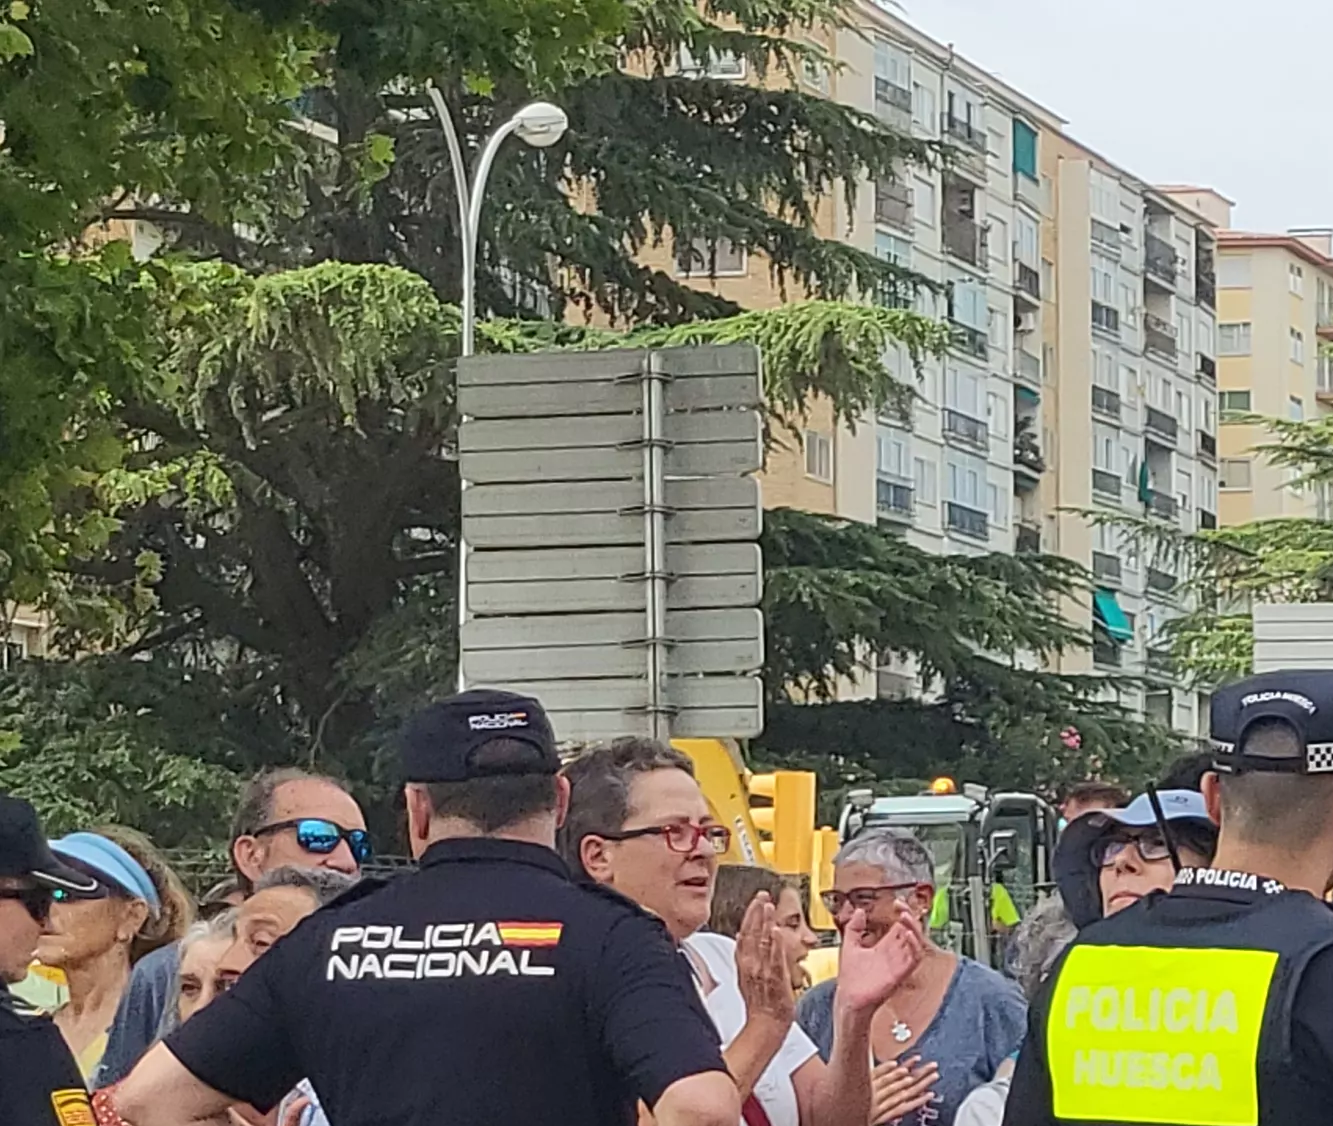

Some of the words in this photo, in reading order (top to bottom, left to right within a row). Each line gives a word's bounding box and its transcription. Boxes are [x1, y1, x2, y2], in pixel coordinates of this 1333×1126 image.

[1196, 867, 1257, 890] POLICIA
[326, 950, 555, 981] NACIONAL
[1065, 985, 1239, 1034] POLICIA
[1074, 1049, 1222, 1092] HUESCA
